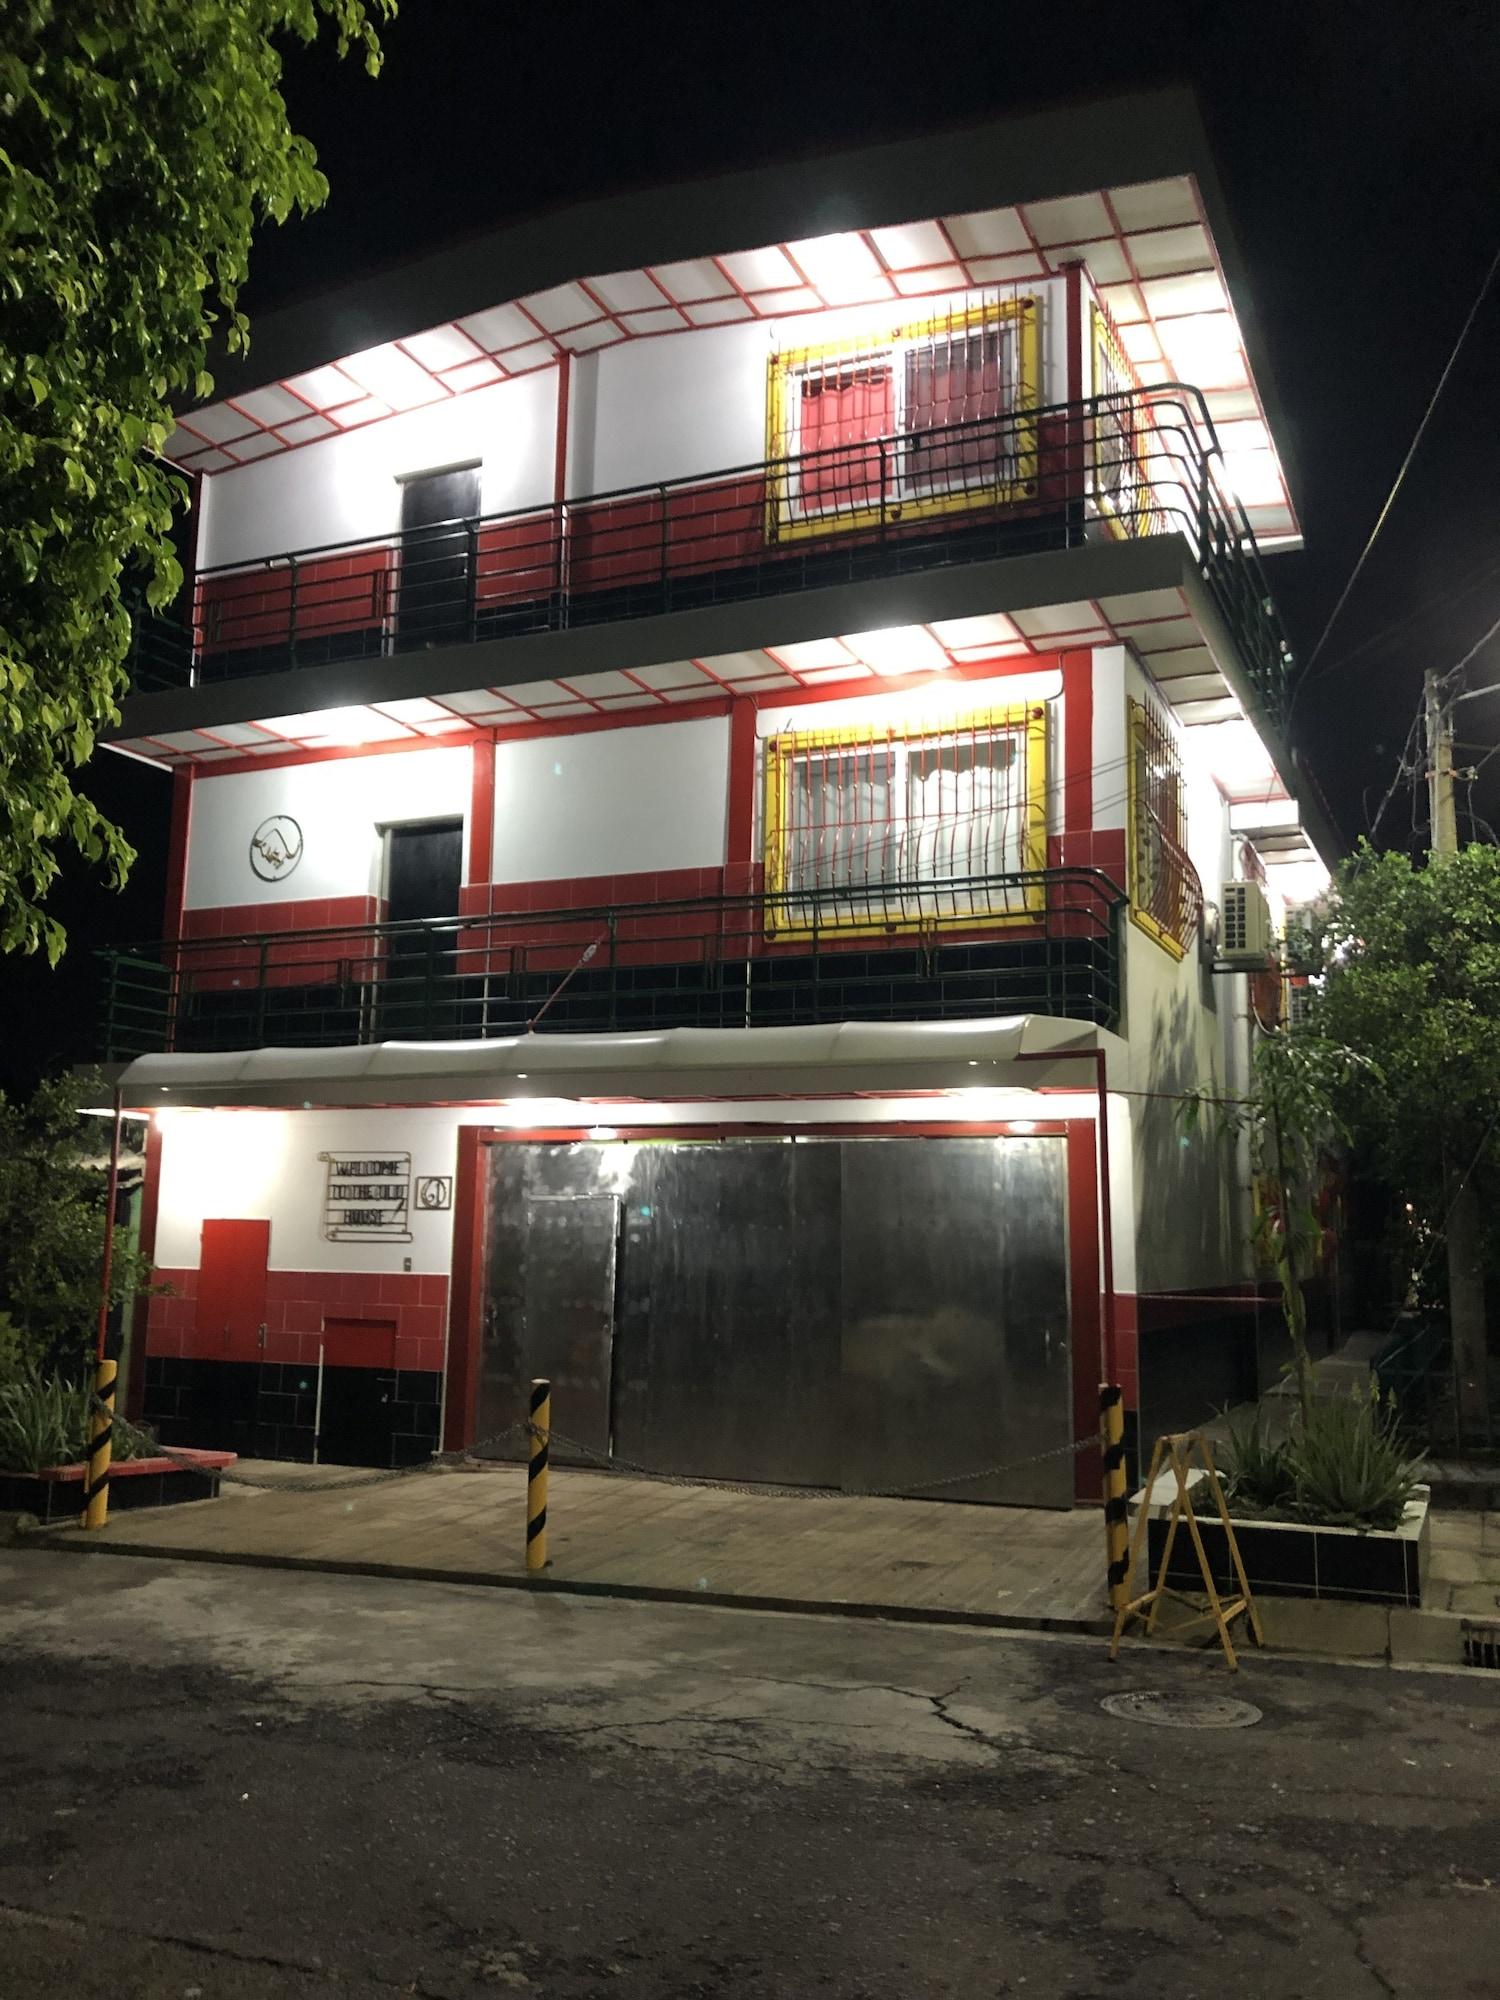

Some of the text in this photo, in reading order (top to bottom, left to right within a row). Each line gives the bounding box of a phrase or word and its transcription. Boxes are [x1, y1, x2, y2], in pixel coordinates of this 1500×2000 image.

[336, 1160, 400, 1176] WELCOME
[332, 1184, 404, 1200] TO THE OLD
[343, 1209, 384, 1226] HOUSE
